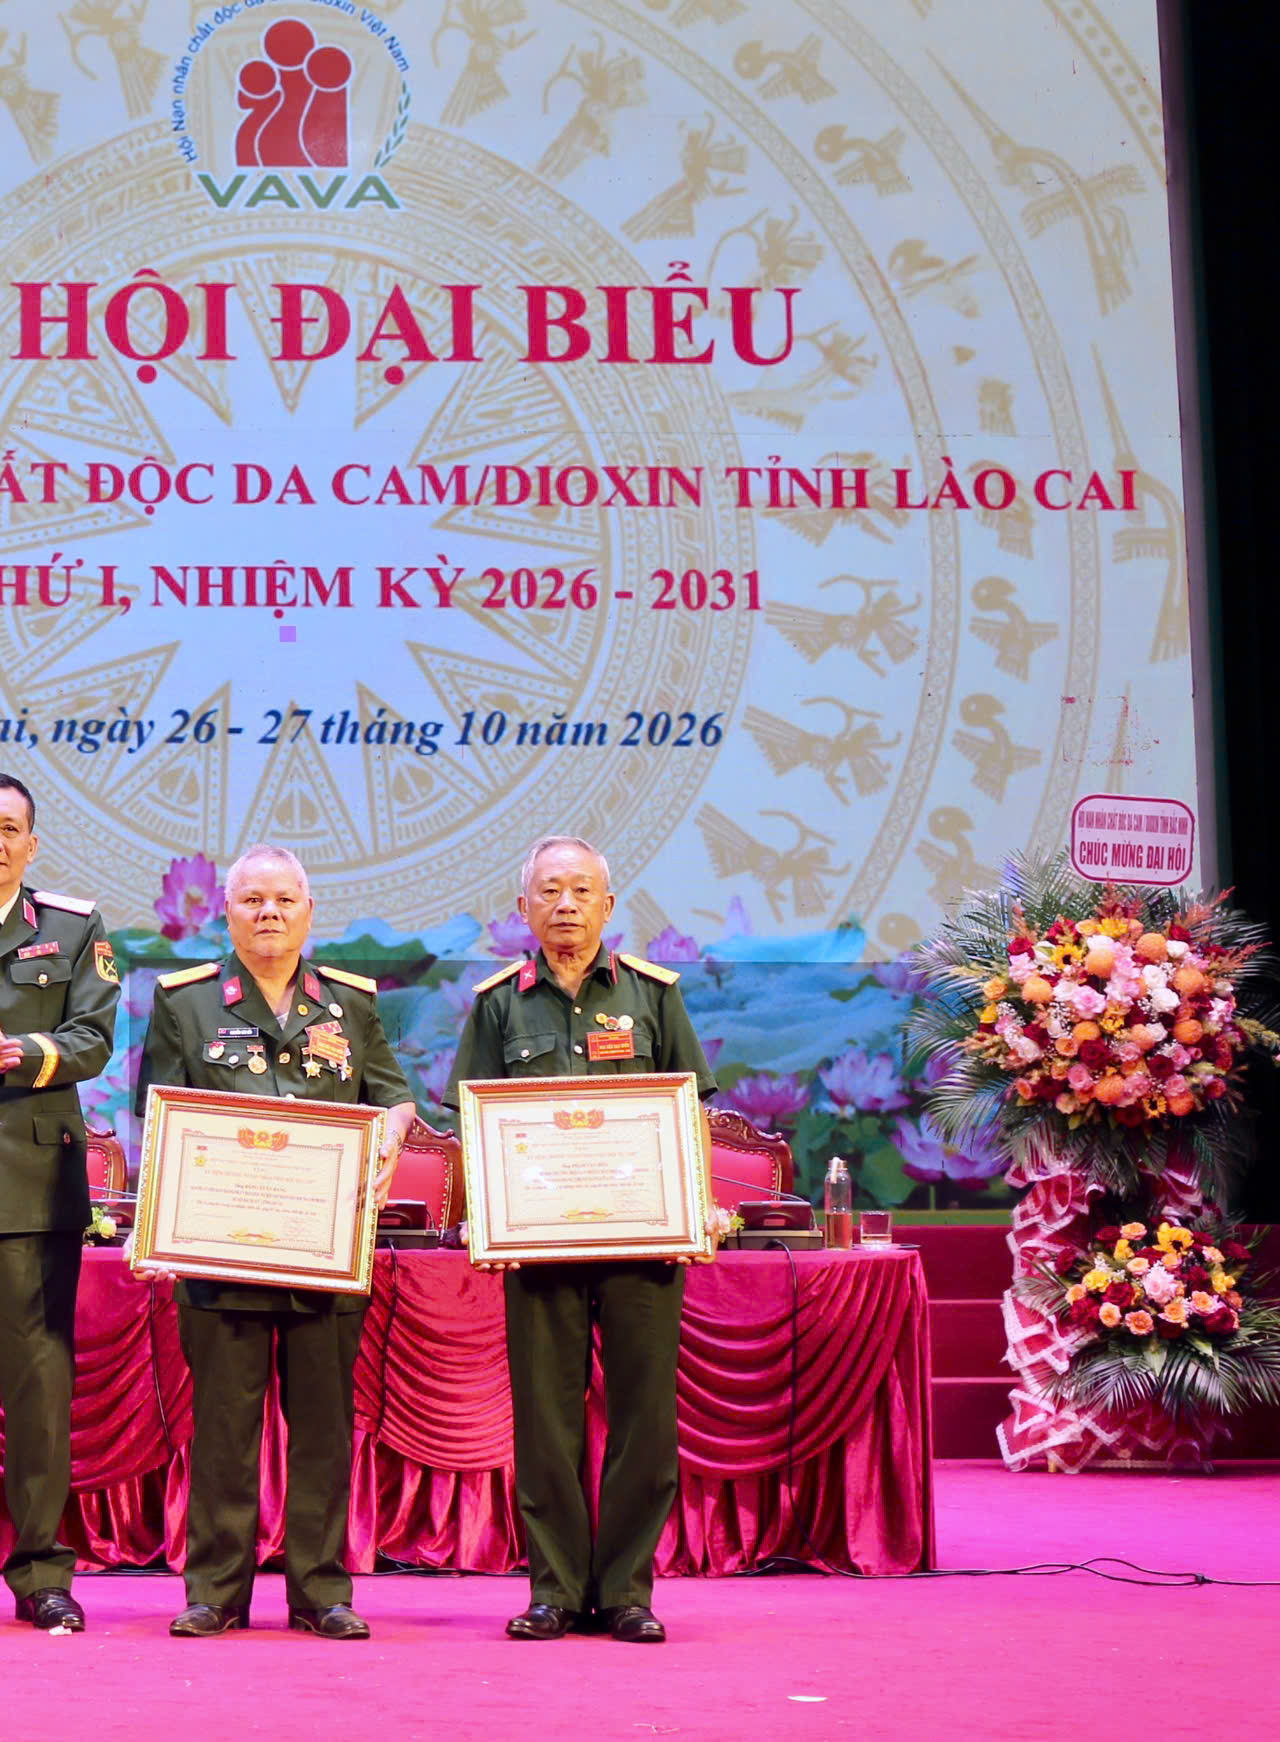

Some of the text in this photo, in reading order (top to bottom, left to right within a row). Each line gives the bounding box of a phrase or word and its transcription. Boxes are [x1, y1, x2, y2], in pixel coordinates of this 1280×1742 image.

[360, 9, 387, 39] Việt
[383, 36, 410, 73] Nam
[197, 174, 402, 210] VAVA
[10, 268, 238, 384] HỘI
[270, 283, 484, 385] ĐẠI
[517, 261, 802, 366] BIỂU
[86, 455, 215, 515] ĐỘC
[233, 463, 317, 505] DA
[331, 463, 705, 508] CAM/DIOXIN
[725, 455, 871, 510] TỈNH
[892, 455, 1017, 511] LÀO
[1033, 468, 1138, 511] CAI
[98, 565, 132, 616] I,
[151, 559, 356, 619] NHIỆM
[376, 554, 465, 608] KỲ
[480, 567, 599, 610] 2026
[650, 568, 763, 611] 2031
[51, 705, 155, 755] ngày
[165, 708, 219, 745] 26
[257, 708, 313, 745] 27
[319, 707, 445, 757] tháng
[453, 710, 508, 747] 10
[514, 713, 610, 748] năm
[618, 711, 725, 748] 2026
[1079, 838, 1186, 875] CHÚC MỪNG ĐẠI HỘI
